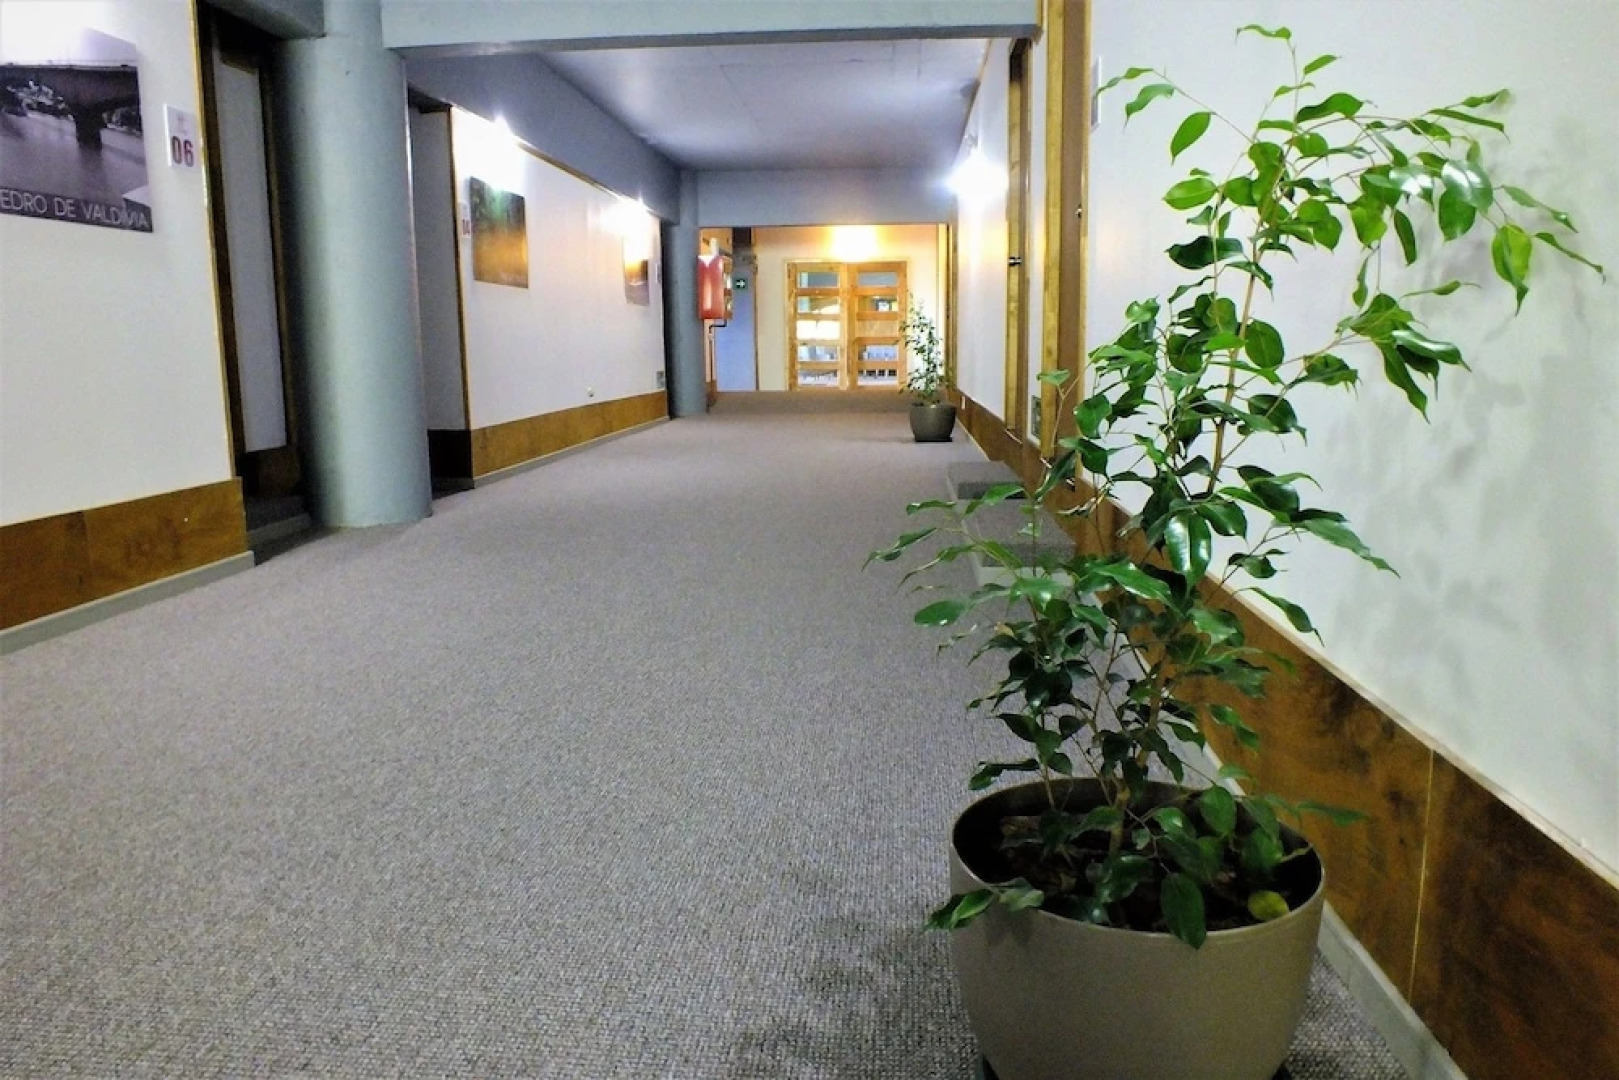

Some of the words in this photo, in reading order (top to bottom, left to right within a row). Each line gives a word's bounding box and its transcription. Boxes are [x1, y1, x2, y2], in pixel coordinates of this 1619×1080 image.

[171, 136, 194, 167] 06
[54, 197, 76, 218] DE
[80, 201, 149, 229] VALDIVIA
